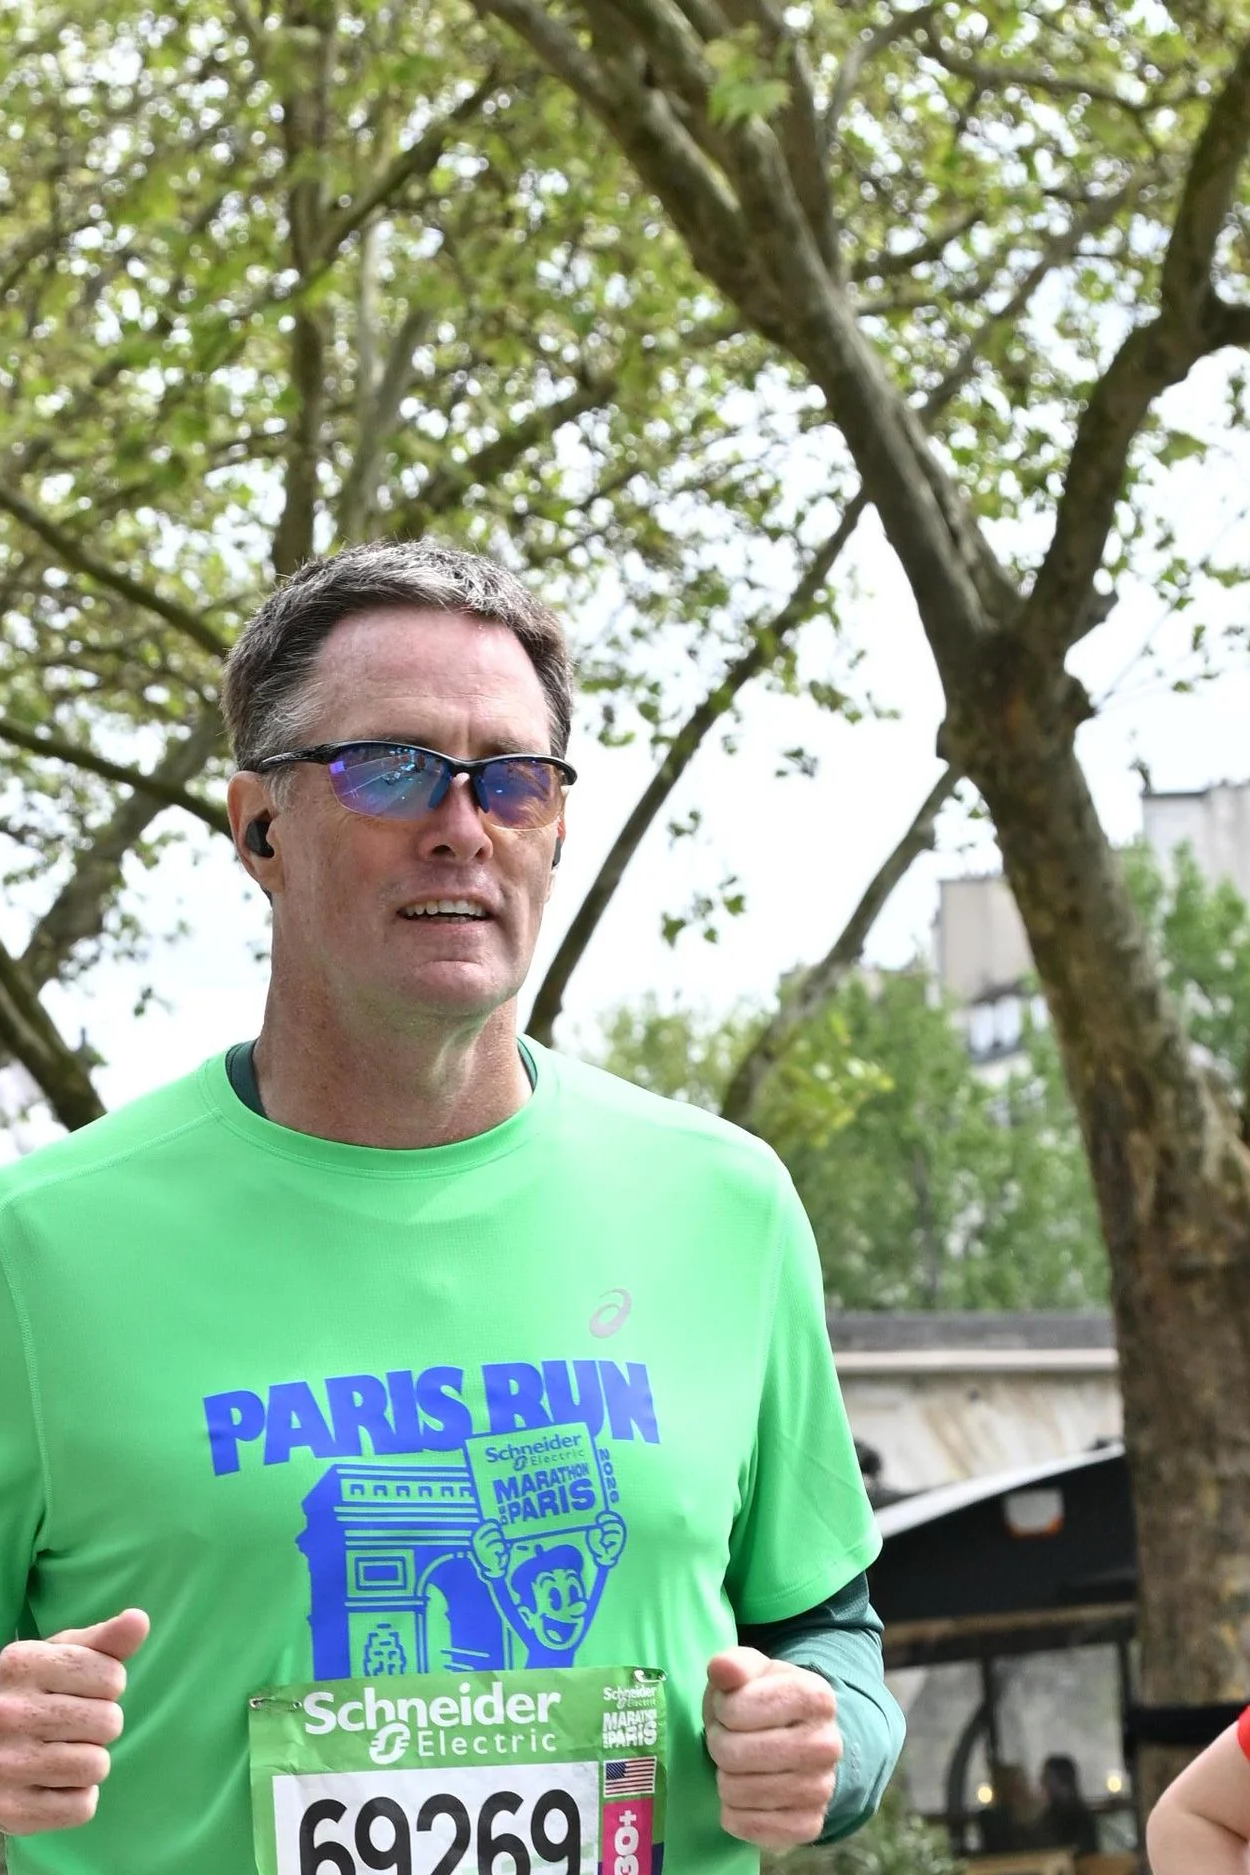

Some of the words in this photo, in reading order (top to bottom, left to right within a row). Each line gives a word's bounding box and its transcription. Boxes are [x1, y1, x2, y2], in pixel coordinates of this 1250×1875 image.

[202, 1366, 474, 1476] PARIS
[481, 1360, 660, 1443] RUN
[485, 1433, 582, 1463] Schneider
[531, 1449, 585, 1466] Electric
[493, 1462, 590, 1504] MARATHON
[599, 1448, 620, 1504] 2026
[507, 1478, 596, 1525] PARIS
[303, 1681, 561, 1735] Schneider
[418, 1728, 557, 1757] Electric
[607, 1720, 657, 1748] PARIS
